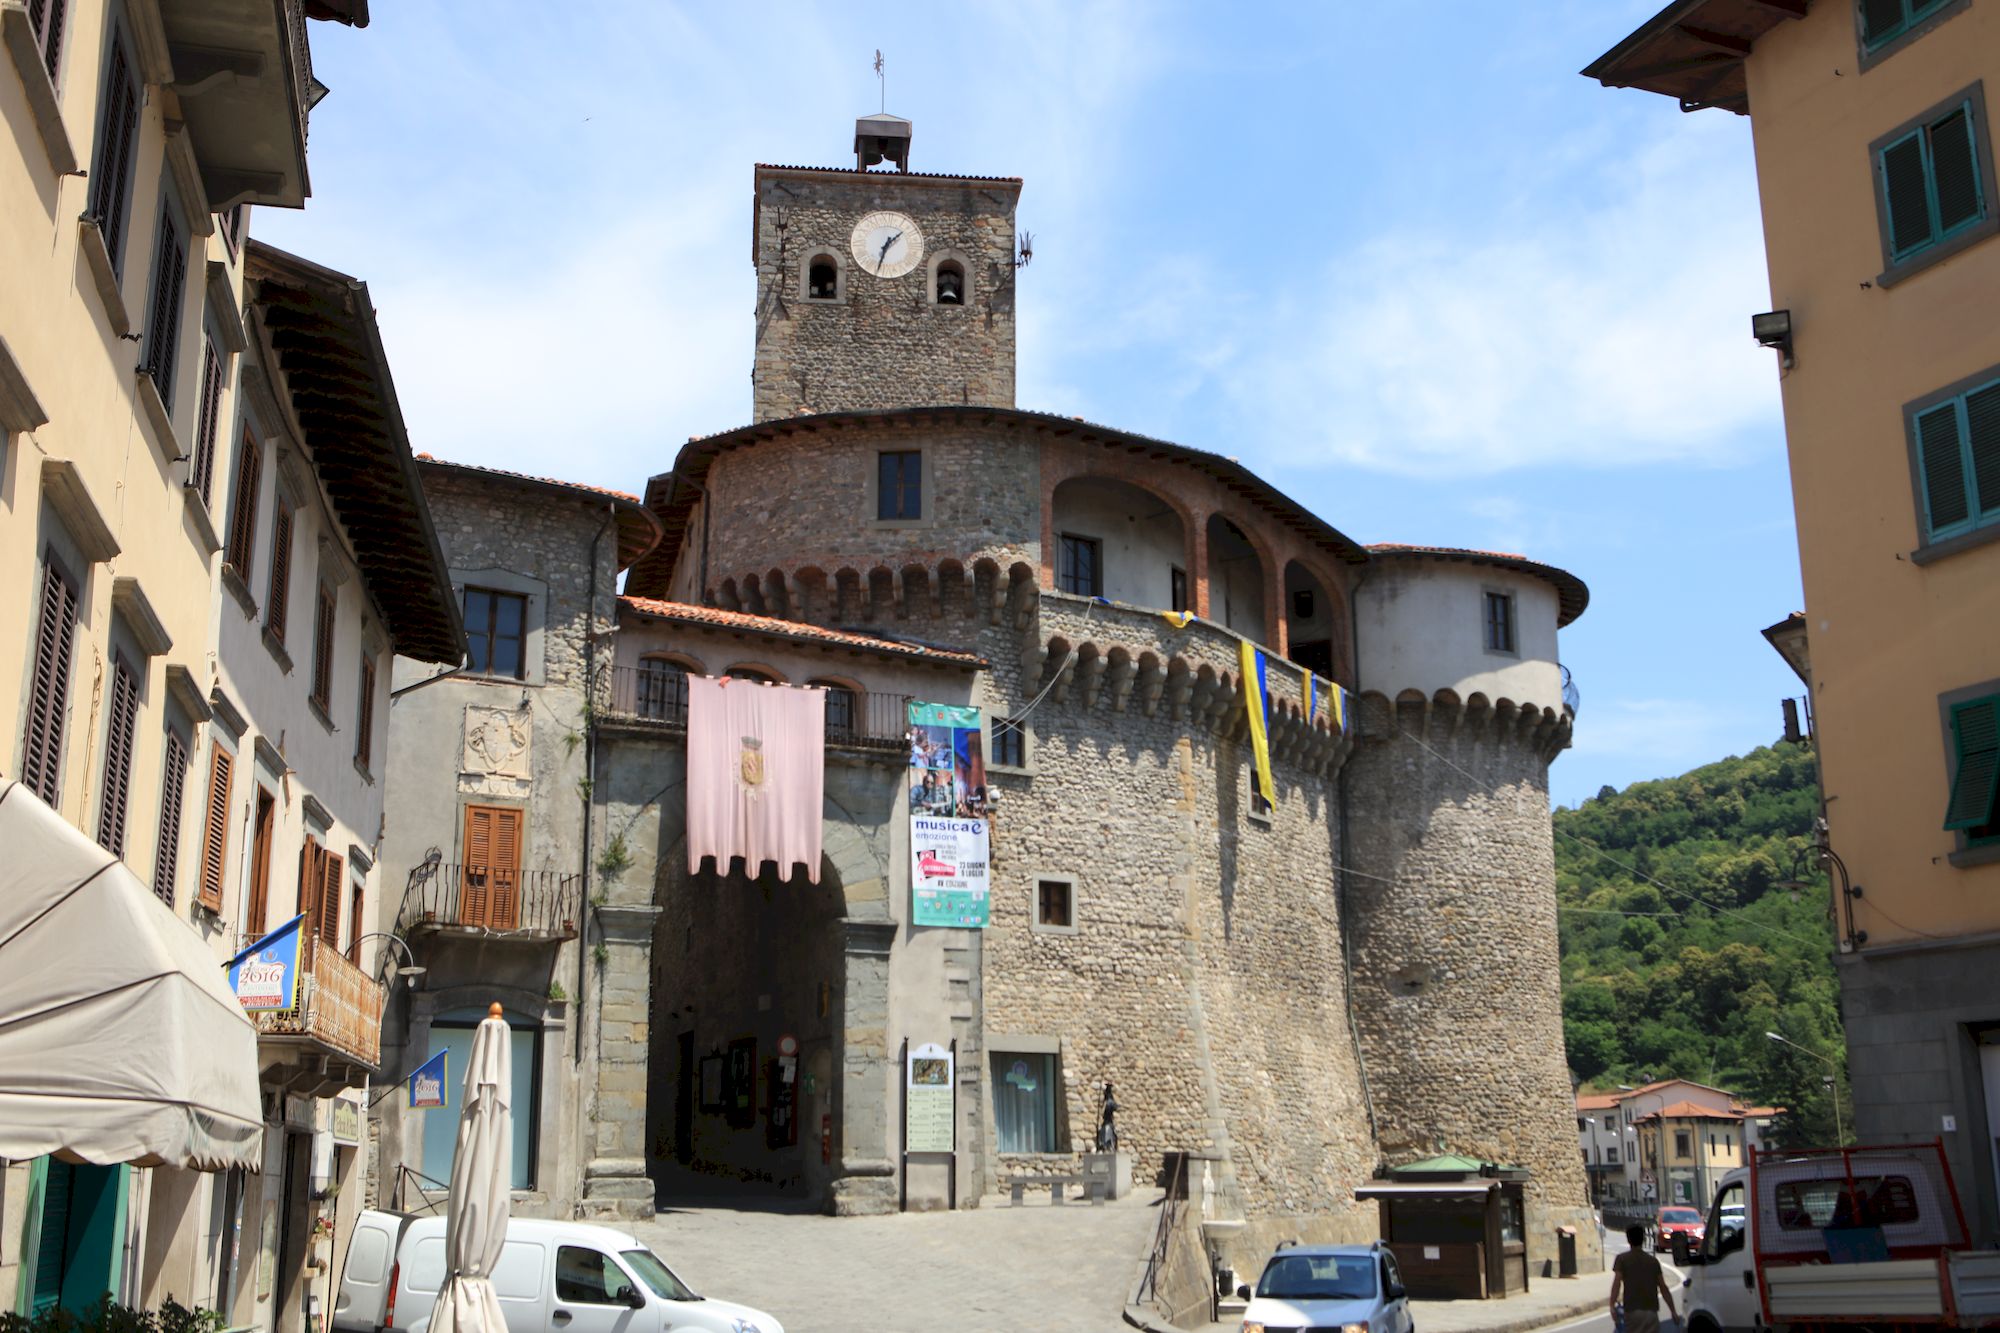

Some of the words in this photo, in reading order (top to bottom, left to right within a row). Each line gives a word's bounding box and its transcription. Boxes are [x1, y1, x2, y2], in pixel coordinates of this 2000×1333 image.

[915, 820, 969, 832] musica
[915, 833, 958, 841] emozione
[240, 968, 280, 984] 2016
